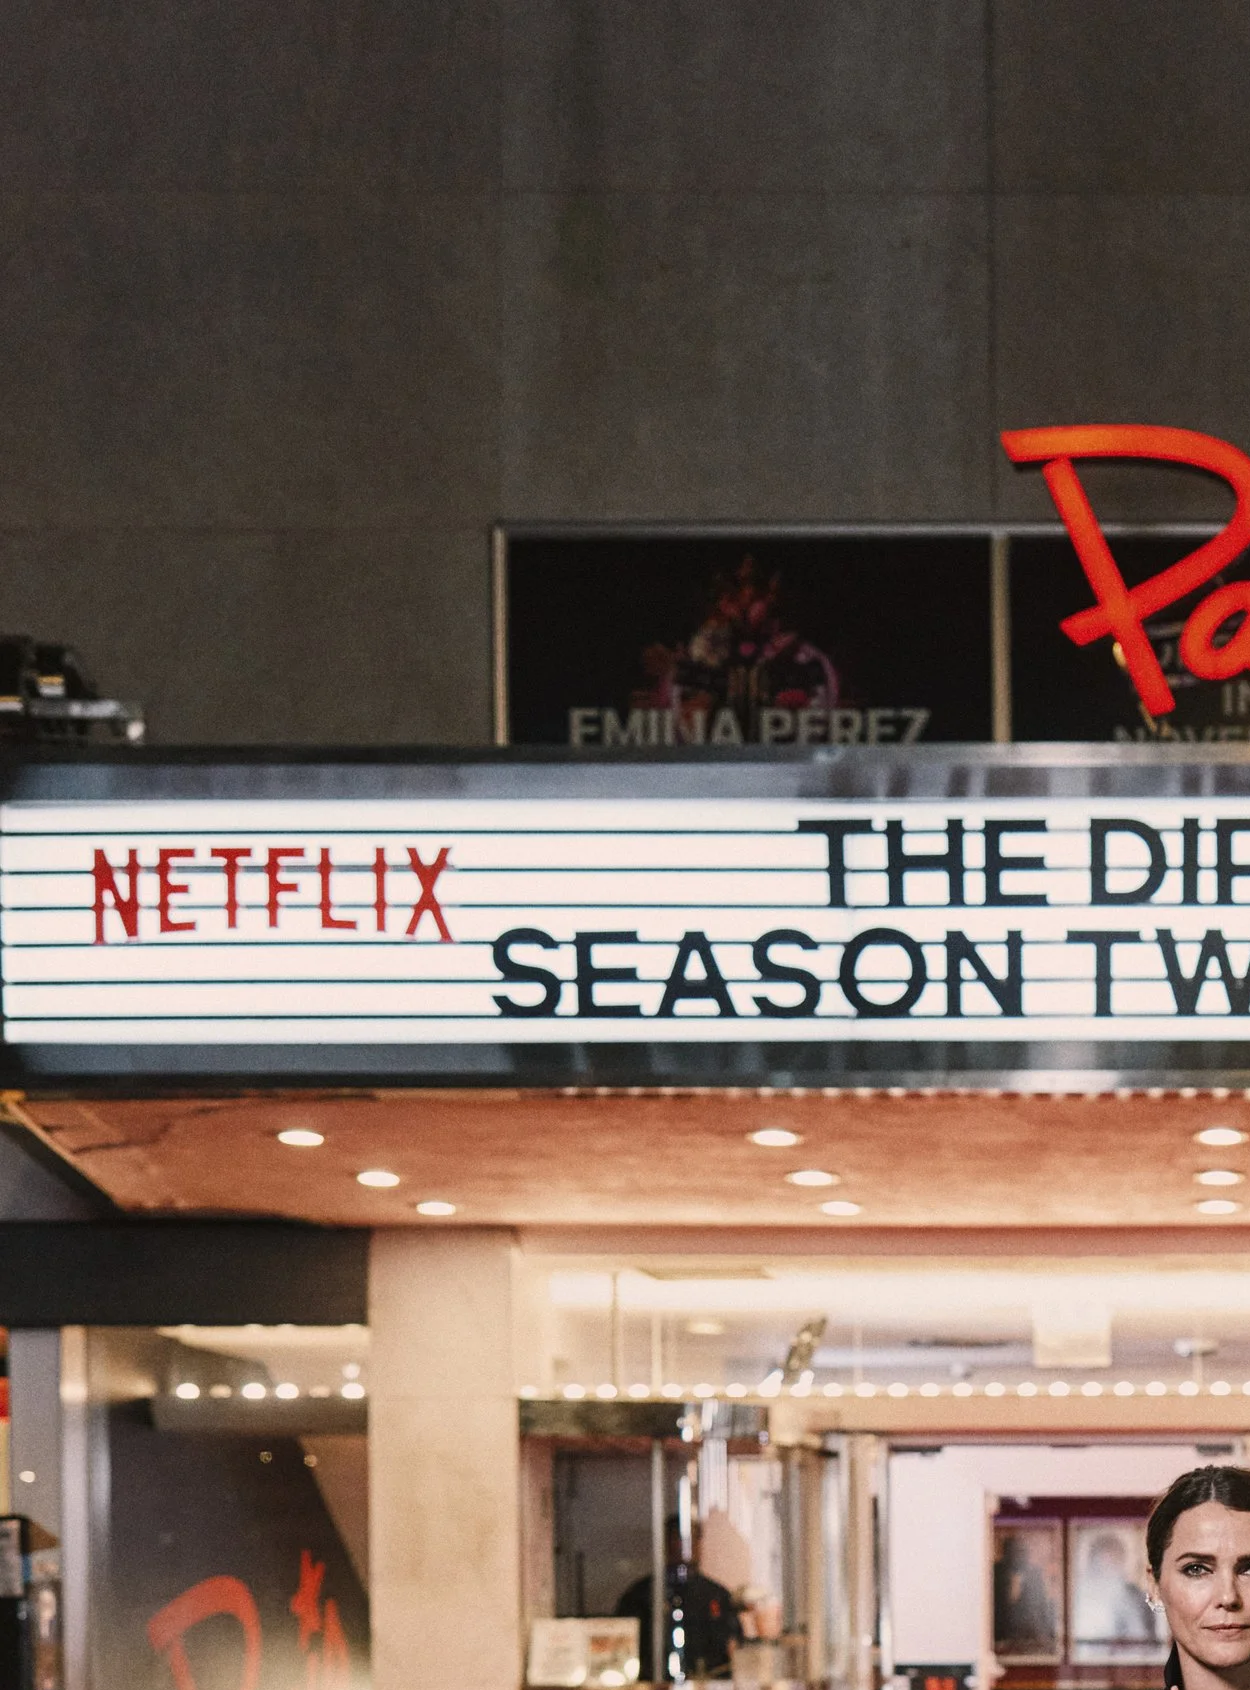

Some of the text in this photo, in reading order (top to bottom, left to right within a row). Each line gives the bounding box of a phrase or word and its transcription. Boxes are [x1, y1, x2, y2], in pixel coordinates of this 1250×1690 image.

[91, 847, 455, 944] NETFLIX
[798, 819, 1048, 909] THE
[492, 927, 1023, 1018] SEASON
